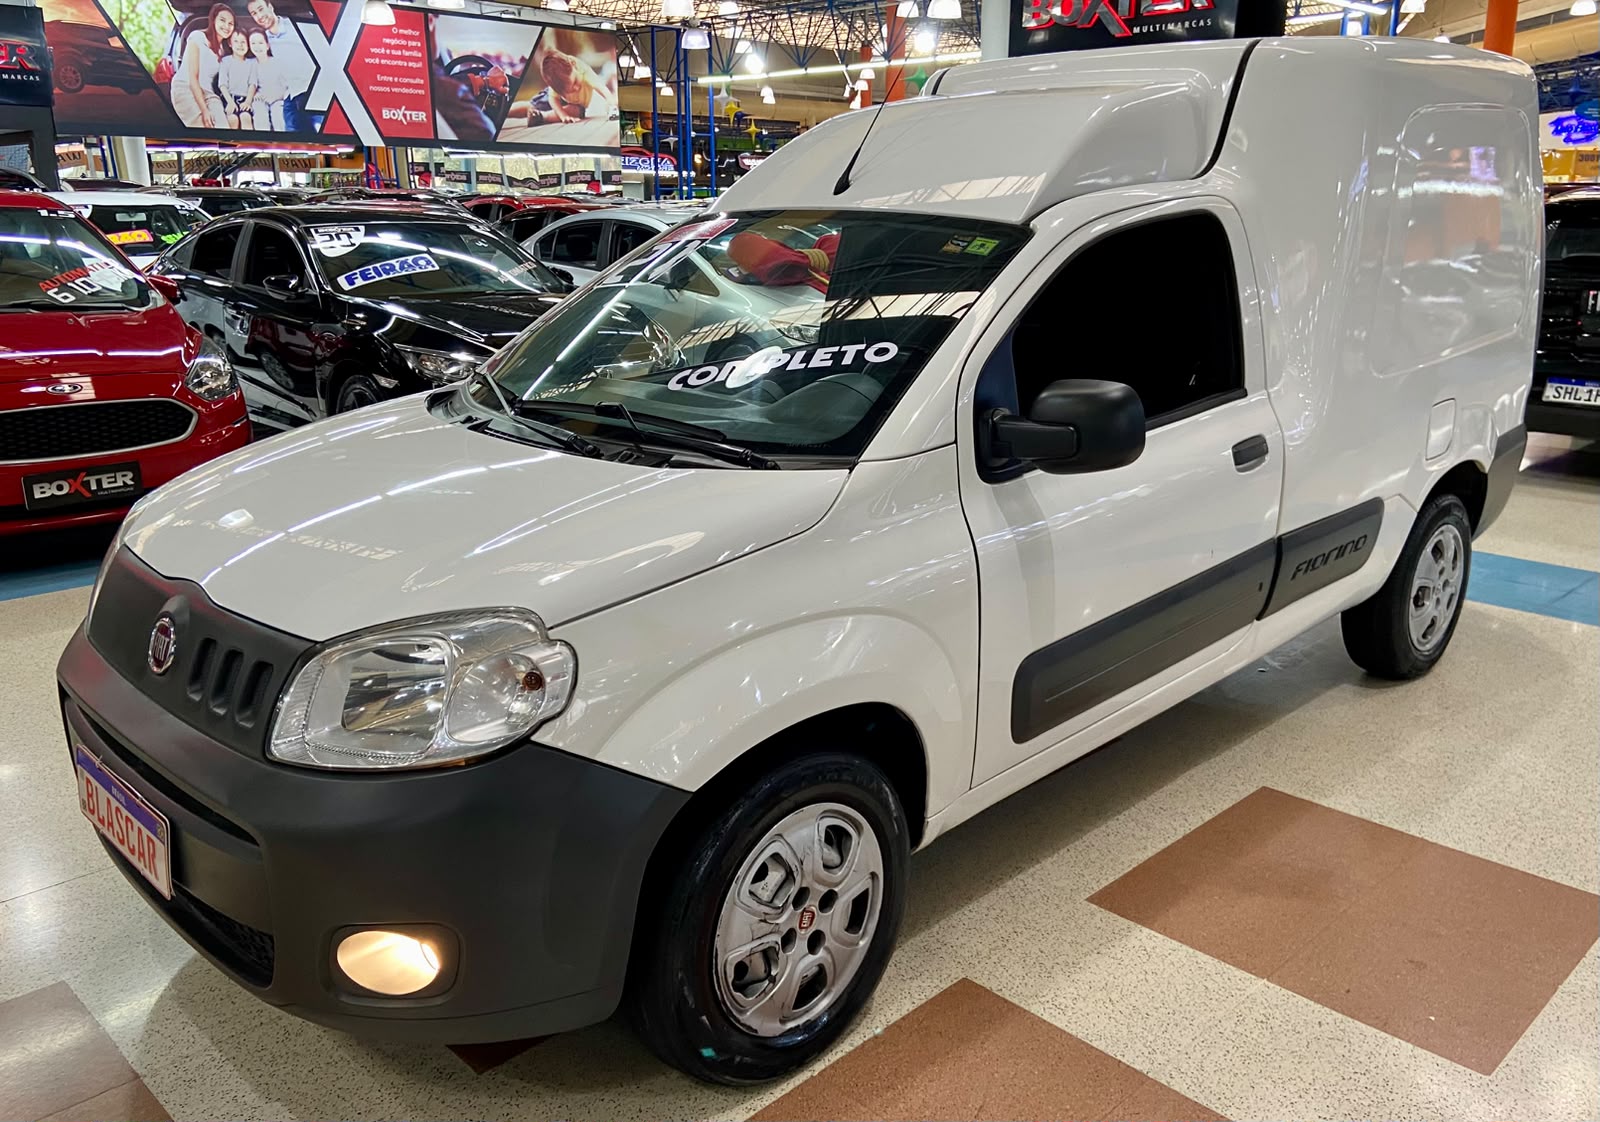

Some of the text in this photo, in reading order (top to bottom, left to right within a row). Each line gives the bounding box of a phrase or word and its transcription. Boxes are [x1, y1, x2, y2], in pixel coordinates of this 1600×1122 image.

[1022, 0, 1215, 38] BOX
[1132, 18, 1213, 34] MULTIMARCAS
[399, 28, 420, 36] melhor
[370, 47, 385, 55] você
[364, 57, 380, 65] você
[380, 59, 407, 67] encontra
[376, 74, 393, 82] Entre
[399, 77, 425, 85] consulte
[391, 87, 425, 95] vendedores
[381, 105, 428, 125] BOXTER
[344, 255, 433, 286] FEIRÃO
[32, 471, 135, 500] BOXTER
[85, 776, 160, 881] BLASCAR
